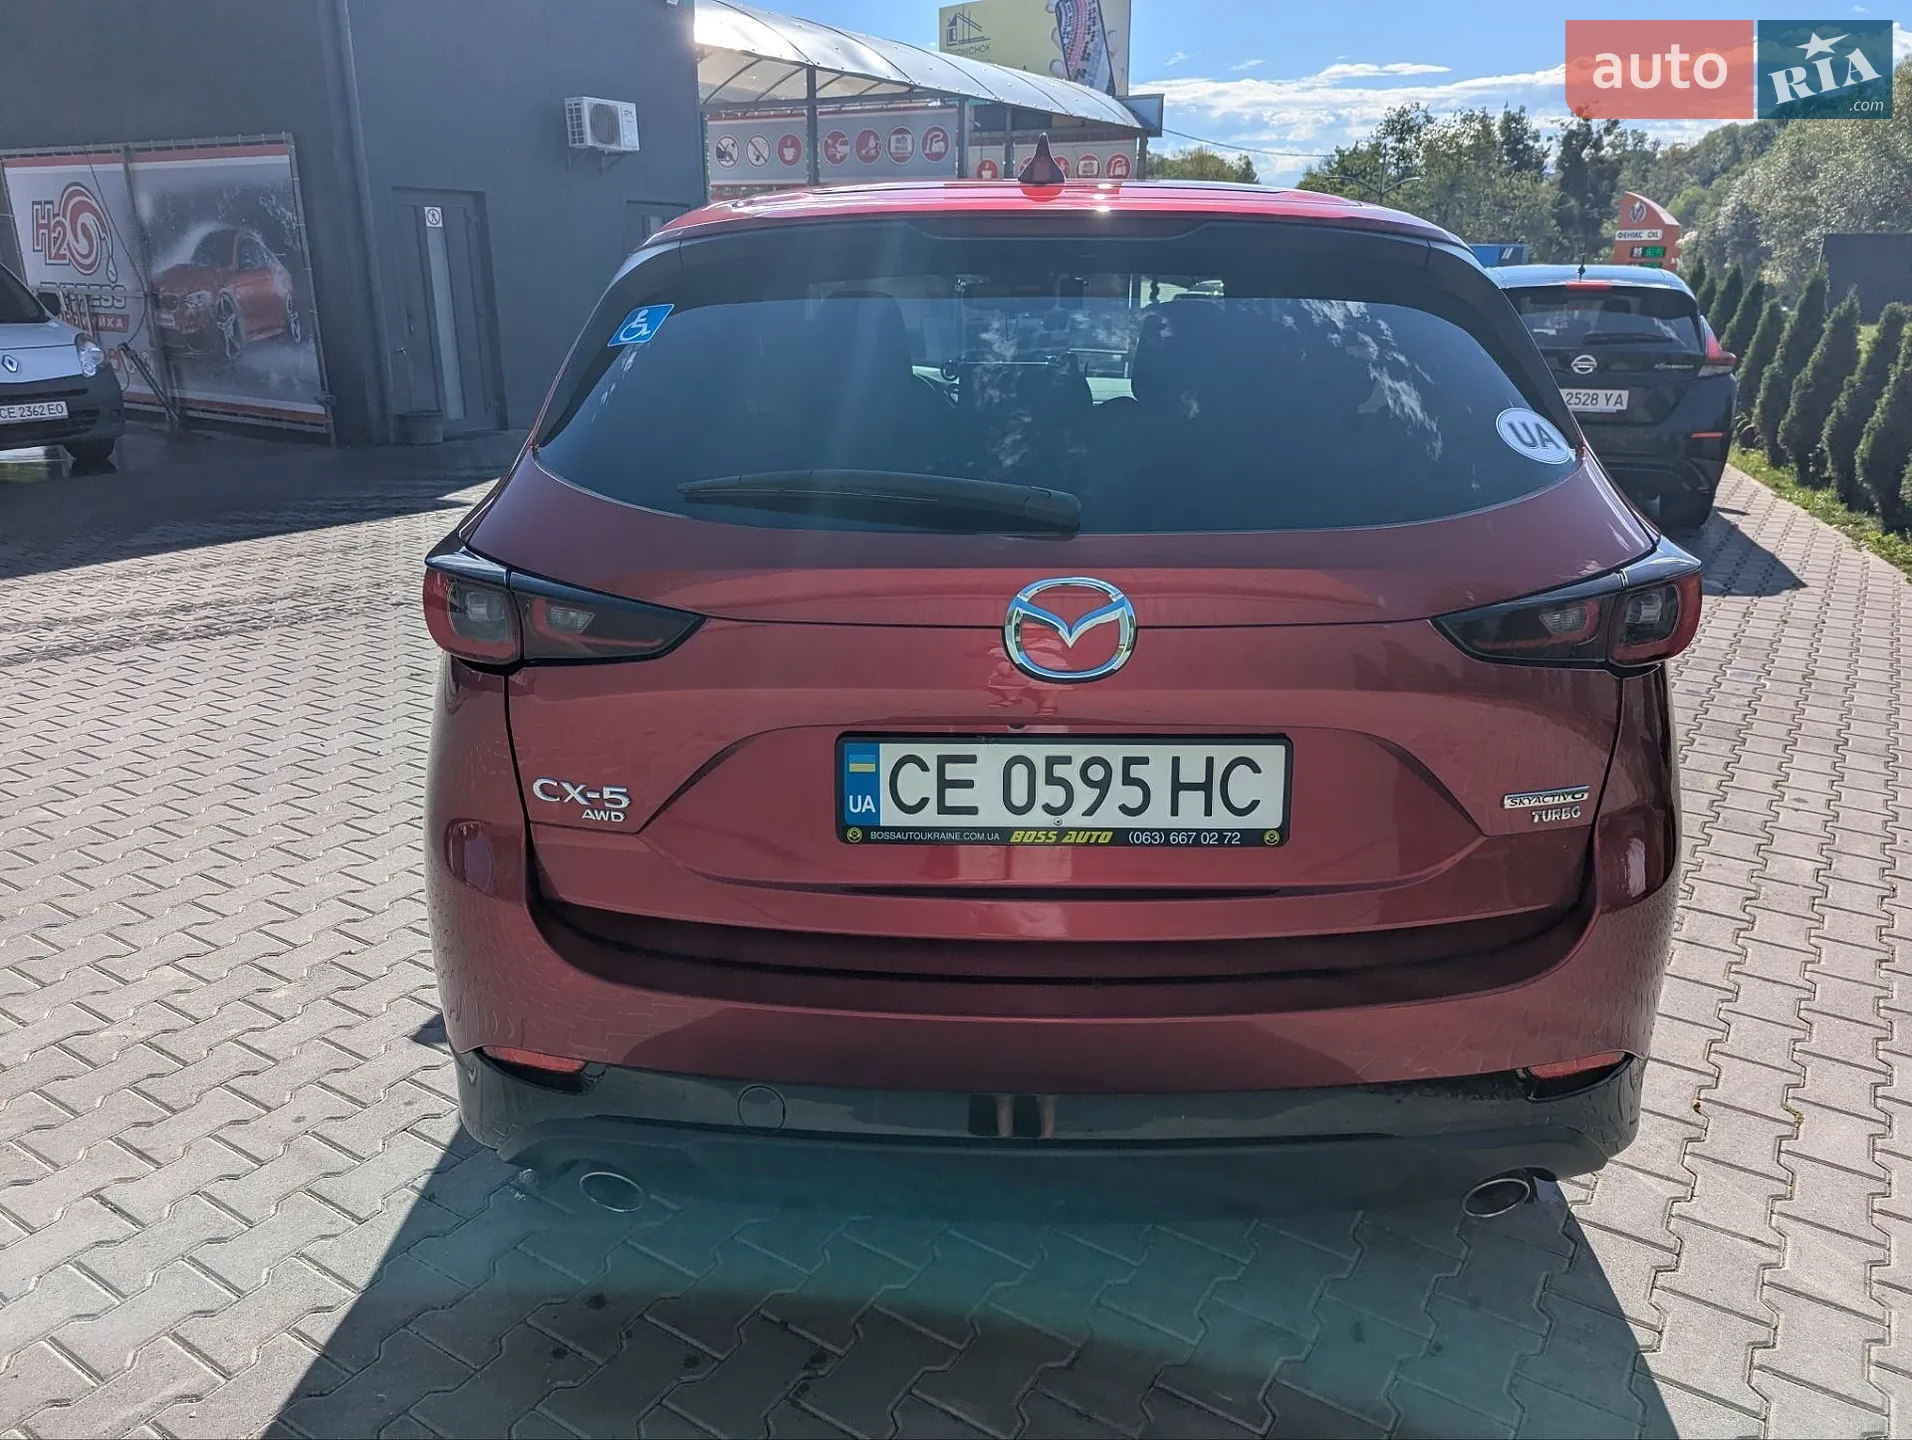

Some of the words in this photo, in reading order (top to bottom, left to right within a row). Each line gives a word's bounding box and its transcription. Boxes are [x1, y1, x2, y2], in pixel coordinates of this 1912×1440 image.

[1566, 392, 1599, 406] 2528
[1605, 393, 1624, 407] YA
[0, 407, 17, 419] CE
[19, 405, 46, 417] 2362
[47, 403, 64, 415] EO
[1506, 422, 1565, 450] UA
[532, 778, 631, 809] CX-5
[889, 754, 979, 815] CE
[1003, 755, 1151, 817] 0595
[1170, 756, 1262, 817] HC
[849, 795, 876, 813] UA
[581, 809, 625, 823] AWD
[1532, 806, 1581, 823] TURBO
[870, 831, 1000, 841] BOSSAUTOUKRAINE.COM.UA
[1010, 830, 1057, 843] BOSS
[1062, 831, 1114, 844] AUTO
[1128, 831, 1165, 845] (063)
[1169, 831, 1197, 844] 667
[1200, 832, 1218, 844] 02
[1223, 832, 1241, 844] 72
